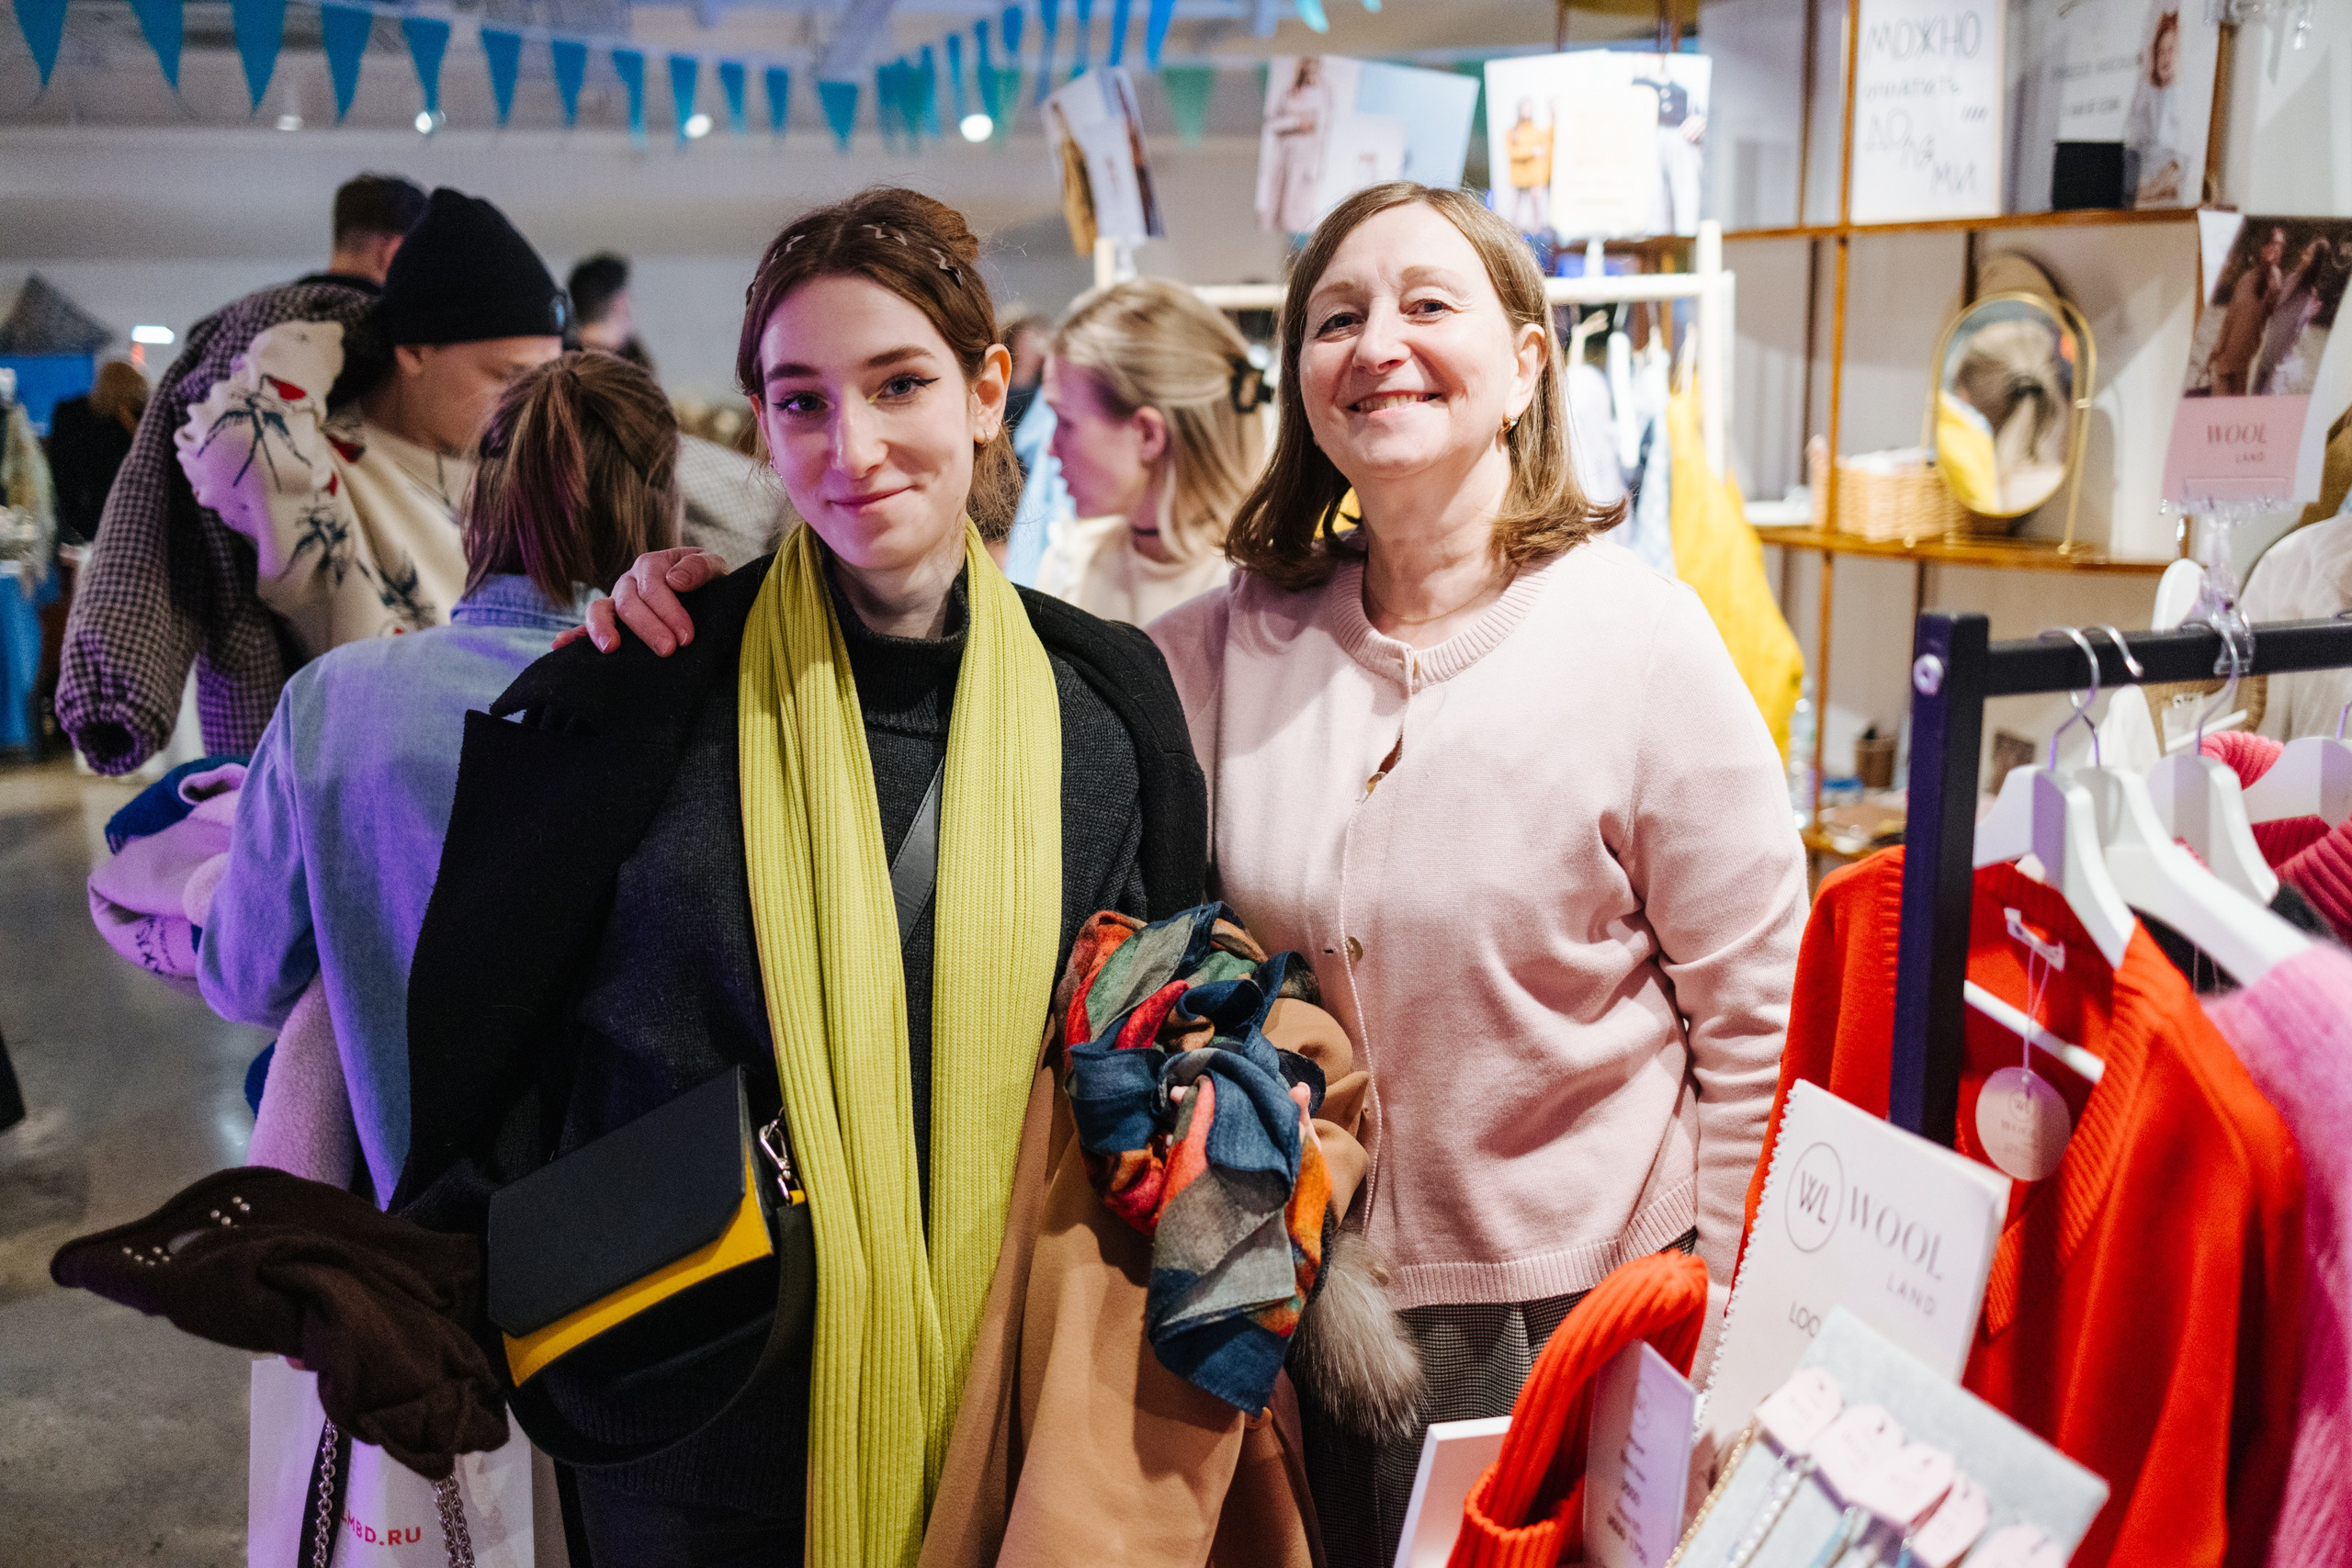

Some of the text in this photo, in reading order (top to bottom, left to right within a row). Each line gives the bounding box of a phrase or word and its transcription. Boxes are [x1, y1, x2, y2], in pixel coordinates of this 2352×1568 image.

[1864, 10, 1983, 64] МОЖНО
[2207, 423, 2267, 445] WOOL
[1850, 1185, 1943, 1281] WOOL
[1886, 1273, 1937, 1317] LAND
